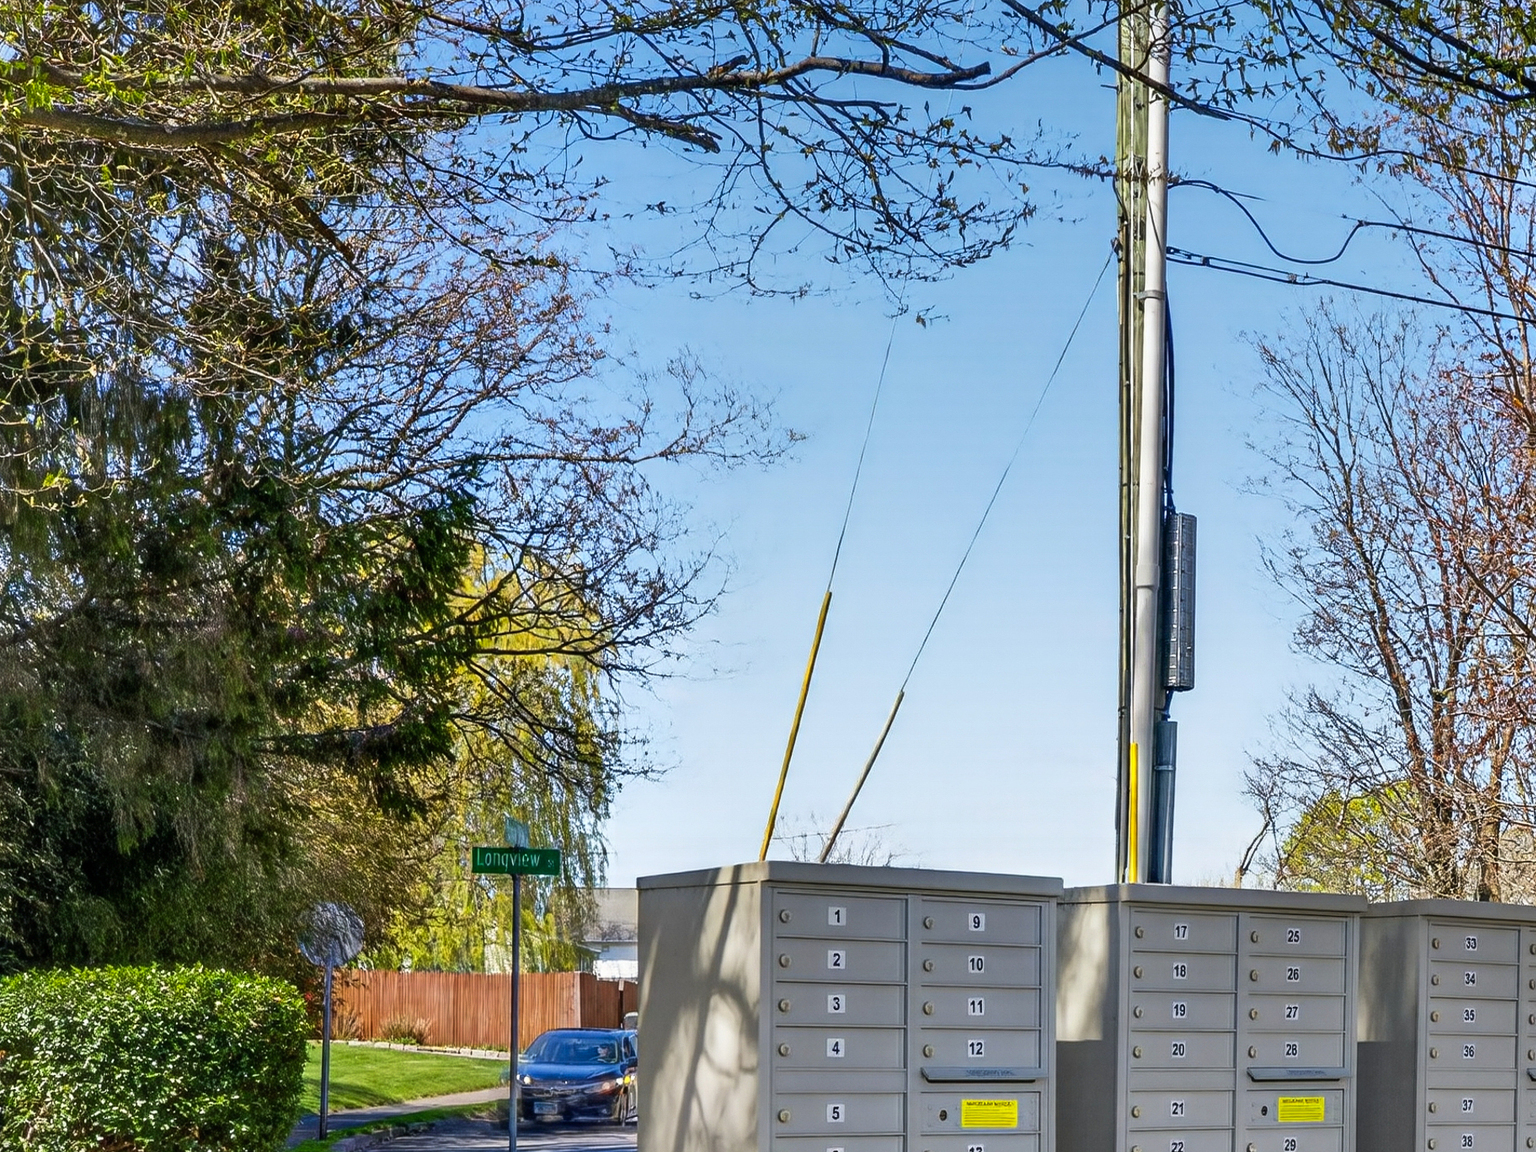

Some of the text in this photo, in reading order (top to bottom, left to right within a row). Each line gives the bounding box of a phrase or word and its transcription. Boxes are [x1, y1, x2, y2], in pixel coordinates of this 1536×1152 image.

[476, 847, 541, 872] Longview
[834, 909, 841, 924] 1
[972, 915, 981, 929] 9
[1175, 925, 1188, 939] 17
[1287, 929, 1300, 943] 25
[1466, 937, 1477, 950] 33
[832, 952, 841, 967] 2
[969, 957, 984, 972] 10
[1173, 964, 1187, 978] 18
[1287, 967, 1299, 981] 26
[1465, 972, 1476, 985] 34
[832, 996, 841, 1011] 3
[970, 999, 983, 1014] 11
[1173, 1003, 1186, 1017] 19
[1286, 1006, 1299, 1019] 27
[1463, 1009, 1475, 1021] 35
[831, 1041, 841, 1055] 4
[969, 1041, 983, 1056] 12
[1172, 1043, 1185, 1057] 20
[1285, 1043, 1298, 1056] 28
[1463, 1045, 1475, 1058] 36
[1172, 1102, 1184, 1115] 21
[1462, 1099, 1473, 1111] 37
[831, 1106, 840, 1121] 5
[1284, 1138, 1297, 1152] 29
[1462, 1135, 1473, 1147] 38
